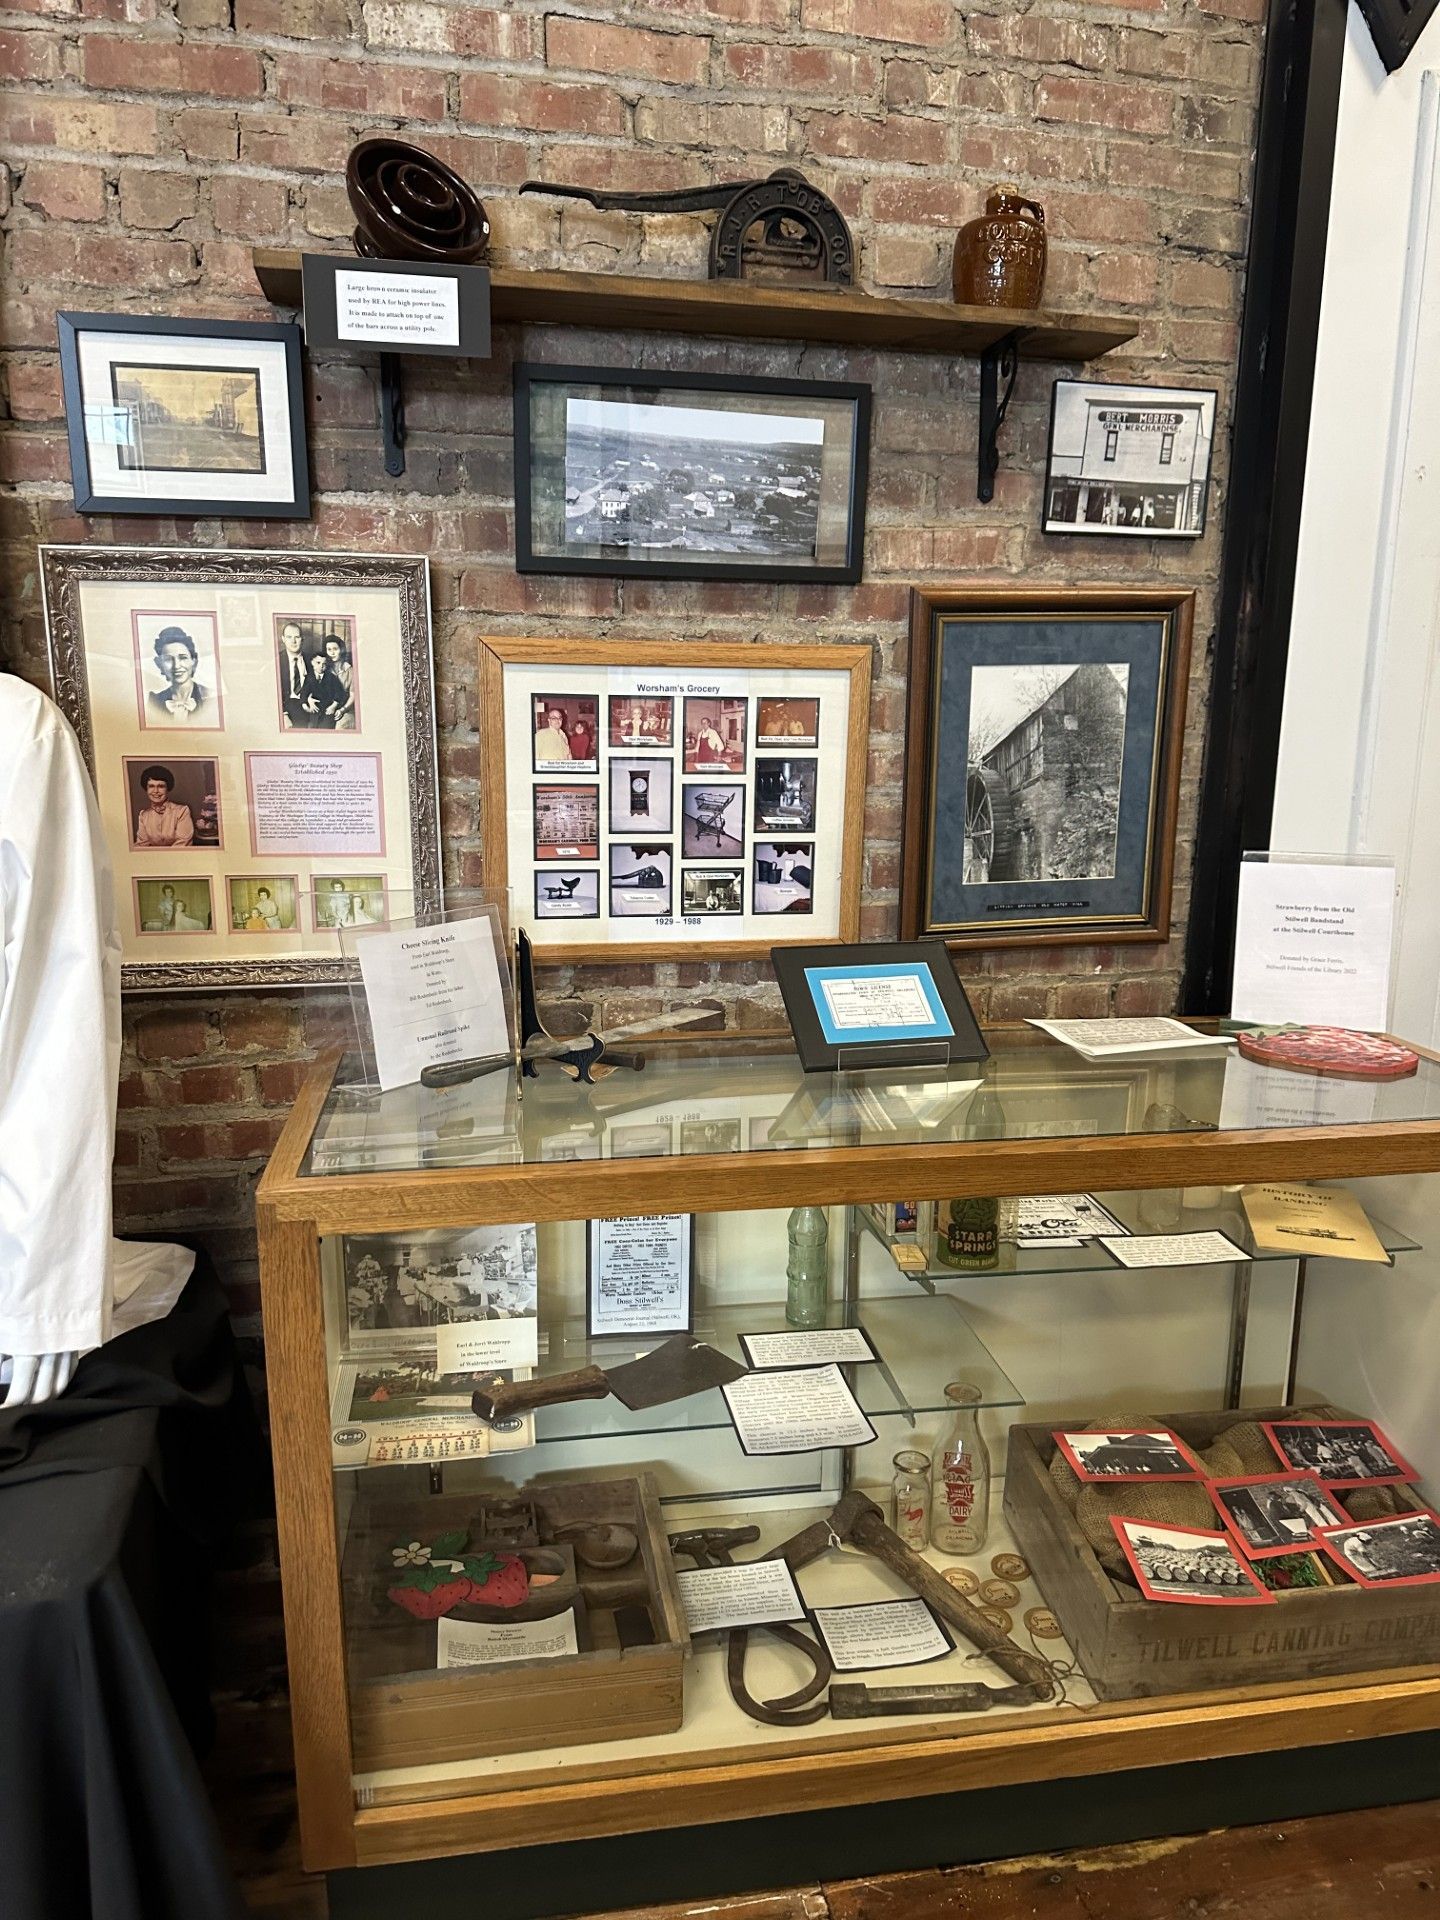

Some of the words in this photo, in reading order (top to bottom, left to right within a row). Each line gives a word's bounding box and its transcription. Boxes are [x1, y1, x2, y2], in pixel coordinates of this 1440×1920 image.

[347, 284, 365, 292] Large
[397, 299, 411, 307] high
[1106, 411, 1128, 422] BERT
[1140, 414, 1176, 424] MORRIS
[636, 683, 684, 693] Worsham's
[687, 684, 720, 695] Grocery
[1276, 904, 1312, 912] Strawberry
[1313, 905, 1329, 913] from
[1331, 905, 1341, 913] the
[684, 917, 701, 925] 1988
[1310, 917, 1344, 925] Bandstand
[1317, 928, 1355, 936] Courthouse
[440, 935, 455, 943] Knife
[1302, 955, 1309, 963] by
[1323, 967, 1343, 975] Library
[417, 1032, 437, 1042] Unusual
[437, 1027, 457, 1037] Railroad
[955, 1231, 992, 1241] STARR
[949, 1240, 996, 1252] SPRINGS
[949, 1506, 973, 1516] DAIRY
[1252, 1622, 1350, 1655] CANNING
